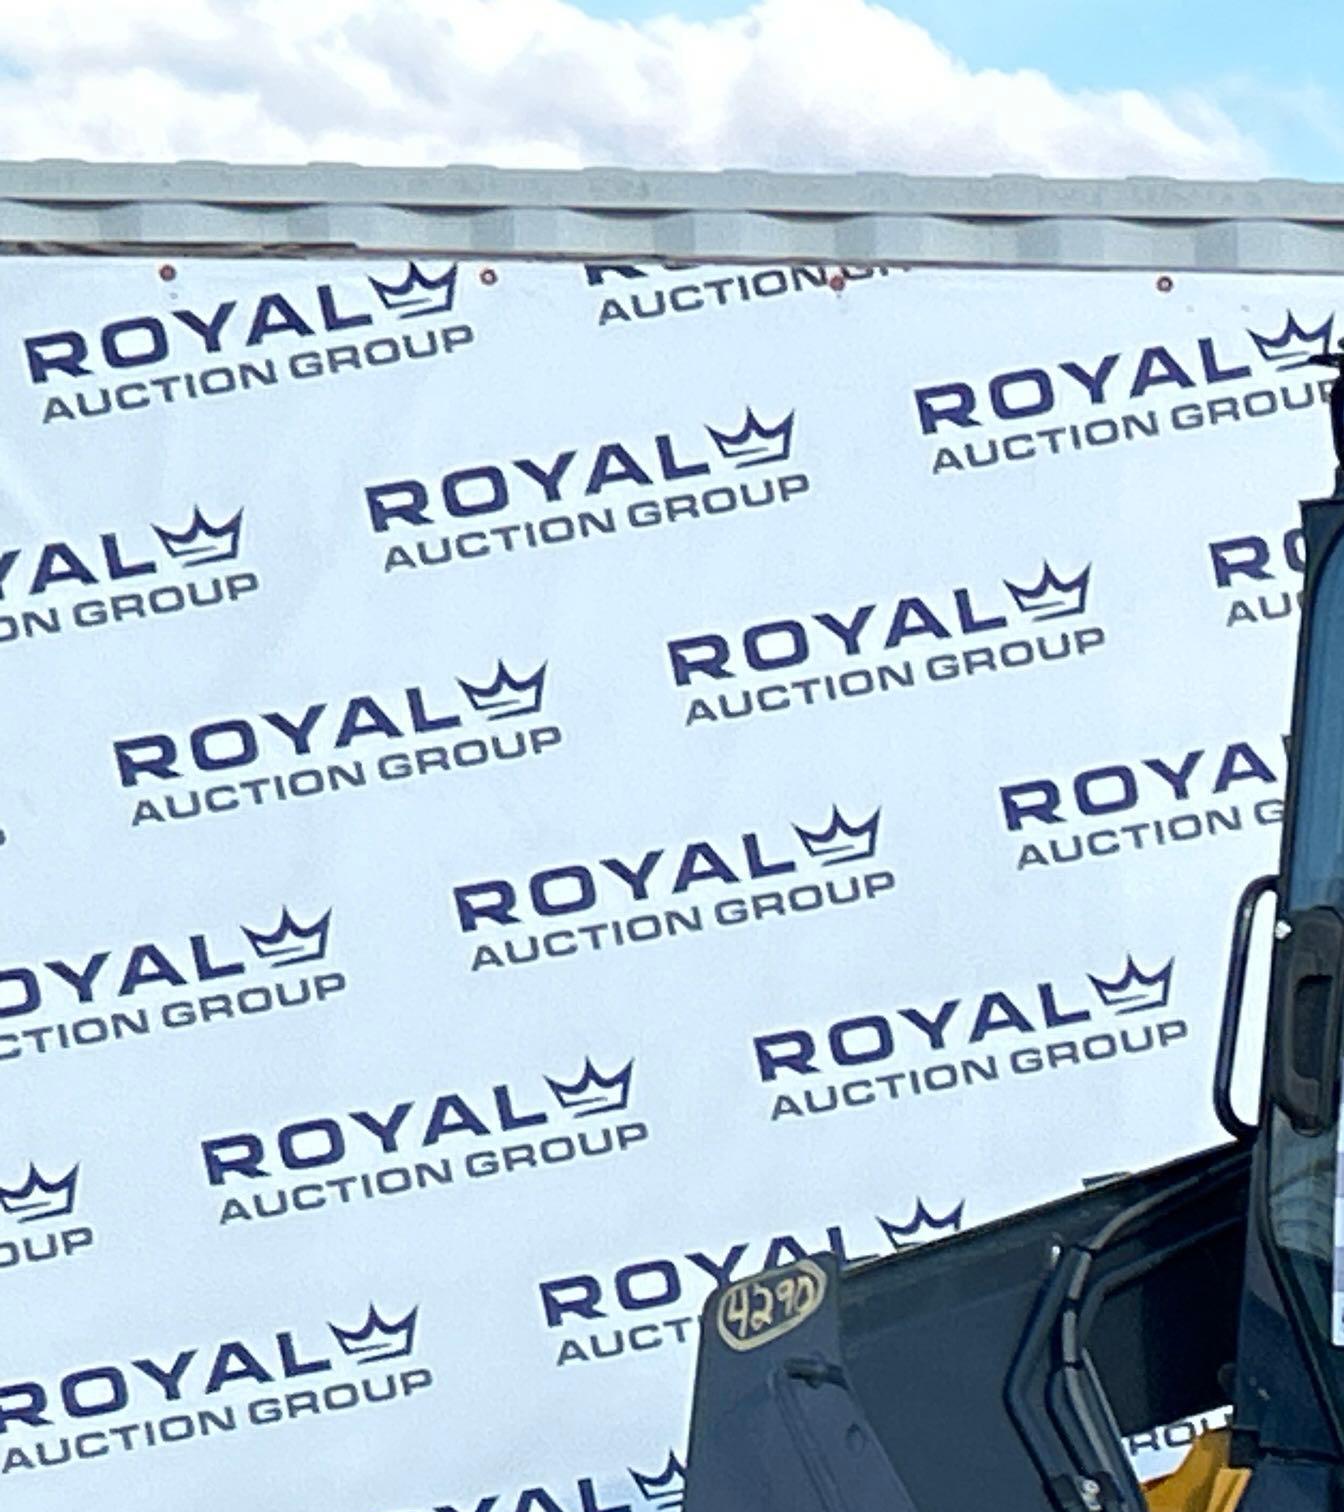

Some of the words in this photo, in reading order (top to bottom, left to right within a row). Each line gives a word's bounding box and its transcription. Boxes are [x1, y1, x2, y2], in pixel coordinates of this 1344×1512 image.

[22, 283, 375, 386] ROYAL
[598, 266, 827, 326] AUCTION
[42, 358, 278, 425] AUCTION
[287, 324, 475, 380] GROUP
[914, 335, 1254, 437] ROYAL
[364, 432, 713, 535] ROYAL
[932, 410, 1160, 476] AUCTION
[383, 507, 617, 574] AUCTION
[626, 473, 811, 529] GROUP
[71, 571, 260, 628] GROUP
[666, 586, 1010, 688] ROYAL
[685, 660, 916, 727] AUCTION
[924, 626, 1107, 682] GROUP
[112, 685, 464, 789] ROYAL
[131, 760, 367, 828] AUCTION
[376, 725, 563, 782] GROUP
[999, 731, 1288, 833] ROYA
[452, 831, 799, 934] ROYAL
[1016, 805, 1244, 872] AUCTION
[471, 905, 704, 973] AUCTION
[713, 870, 897, 927] GROUP
[0, 932, 248, 1022] OYAL
[0, 1008, 151, 1063] CTION
[160, 972, 347, 1030] GROUP
[753, 980, 1094, 1084] ROYAL
[770, 1054, 999, 1122] AUCTION
[1008, 1019, 1190, 1076] GROUP
[200, 1083, 551, 1188] ROYAL
[218, 1158, 454, 1227] AUCTION
[463, 1121, 650, 1179] GROUP
[0, 1330, 334, 1437] ROYAL
[556, 1316, 693, 1368] AUCT
[2, 1405, 237, 1475] AUCTION
[246, 1368, 433, 1426] GROUP
